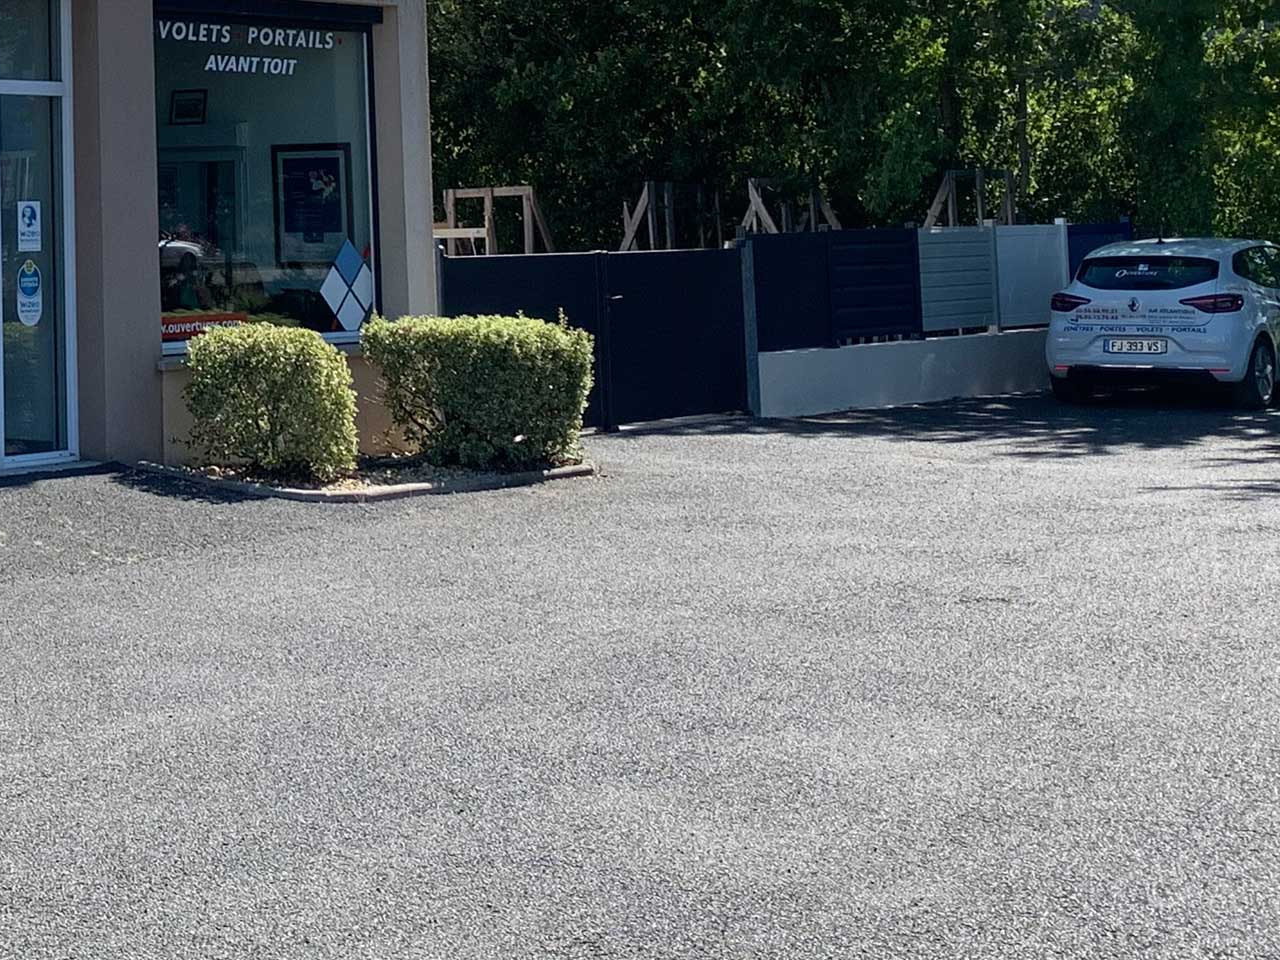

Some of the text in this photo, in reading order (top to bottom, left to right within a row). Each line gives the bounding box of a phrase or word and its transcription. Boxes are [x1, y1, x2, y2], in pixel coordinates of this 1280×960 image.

[158, 20, 334, 50] VOLETS PORTAILS
[205, 54, 297, 76] AVANT TOIT
